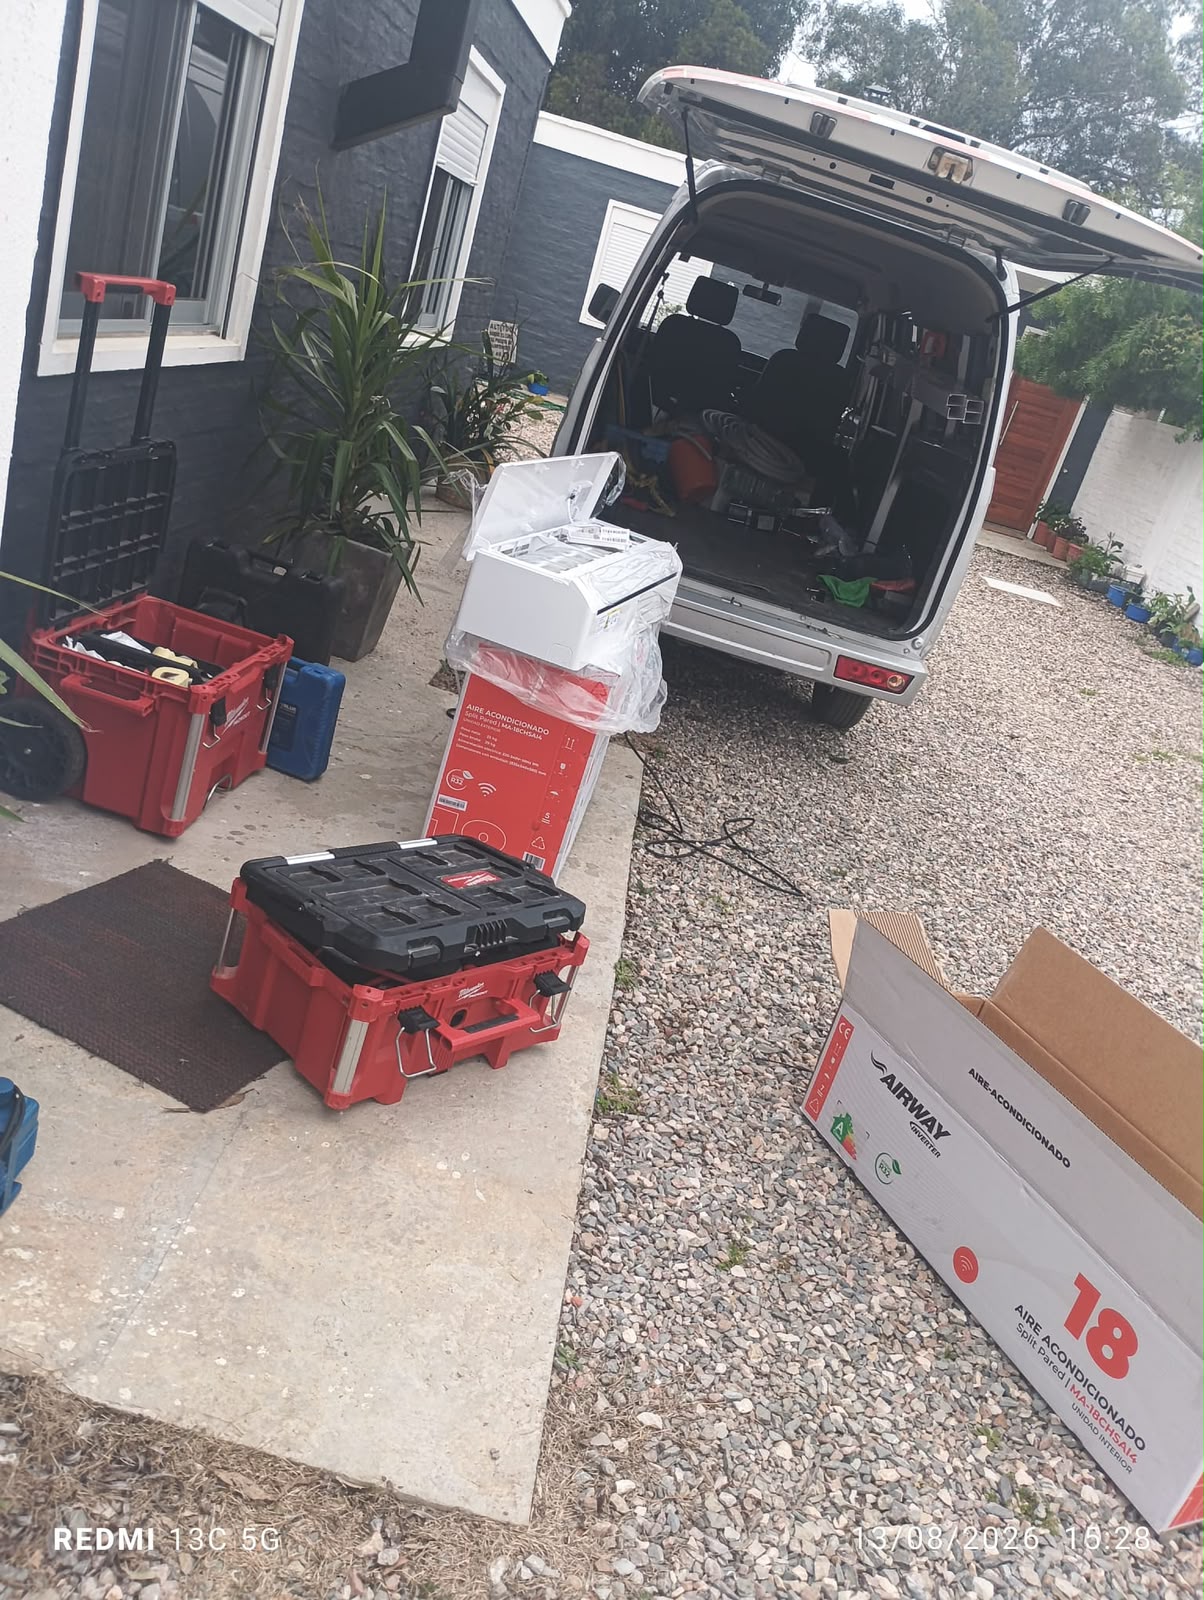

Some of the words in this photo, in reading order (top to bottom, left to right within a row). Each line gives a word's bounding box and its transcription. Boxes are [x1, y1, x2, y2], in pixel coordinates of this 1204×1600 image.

[465, 711, 478, 720] Split
[480, 716, 498, 725] Pared
[466, 703, 485, 714] AIRE
[485, 710, 549, 735] ACONDICIONADO
[880, 1073, 951, 1140] AIRWAY
[968, 1068, 1071, 1168] AIRE-ACONDICIONADO
[910, 1126, 941, 1158] INVERTER
[1016, 1322, 1038, 1351] Split
[1037, 1346, 1066, 1381] Pared
[1063, 1272, 1139, 1379] 18
[1014, 1304, 1043, 1336] AIRE
[1041, 1335, 1146, 1451] ACONDICIONADO
[1071, 1402, 1099, 1437] UNIDAD
[1098, 1436, 1133, 1475] INTERIOR
